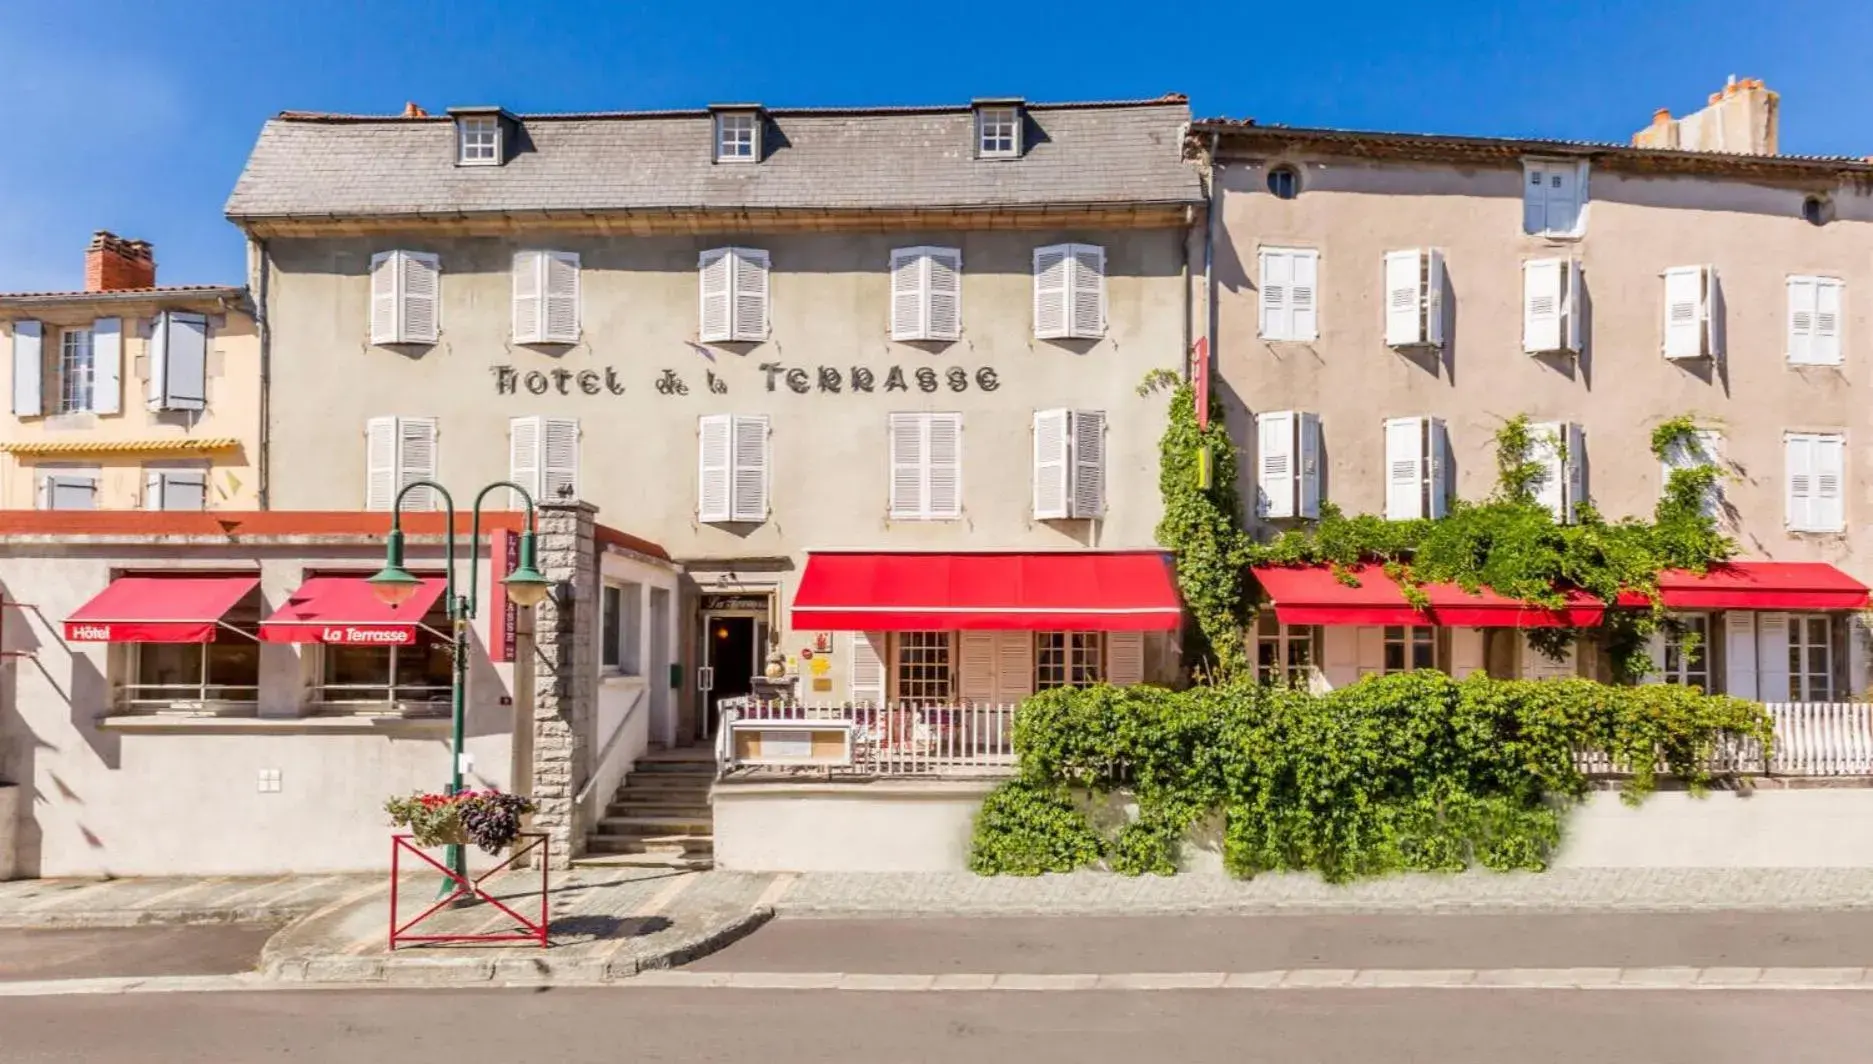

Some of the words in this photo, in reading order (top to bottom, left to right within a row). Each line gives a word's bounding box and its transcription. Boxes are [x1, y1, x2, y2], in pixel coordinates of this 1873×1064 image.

[655, 368, 690, 396] de
[706, 368, 729, 395] la
[507, 535, 517, 557] LA
[72, 624, 111, 640] Hôtel
[322, 627, 342, 641] La
[345, 627, 409, 641] Terrasse
